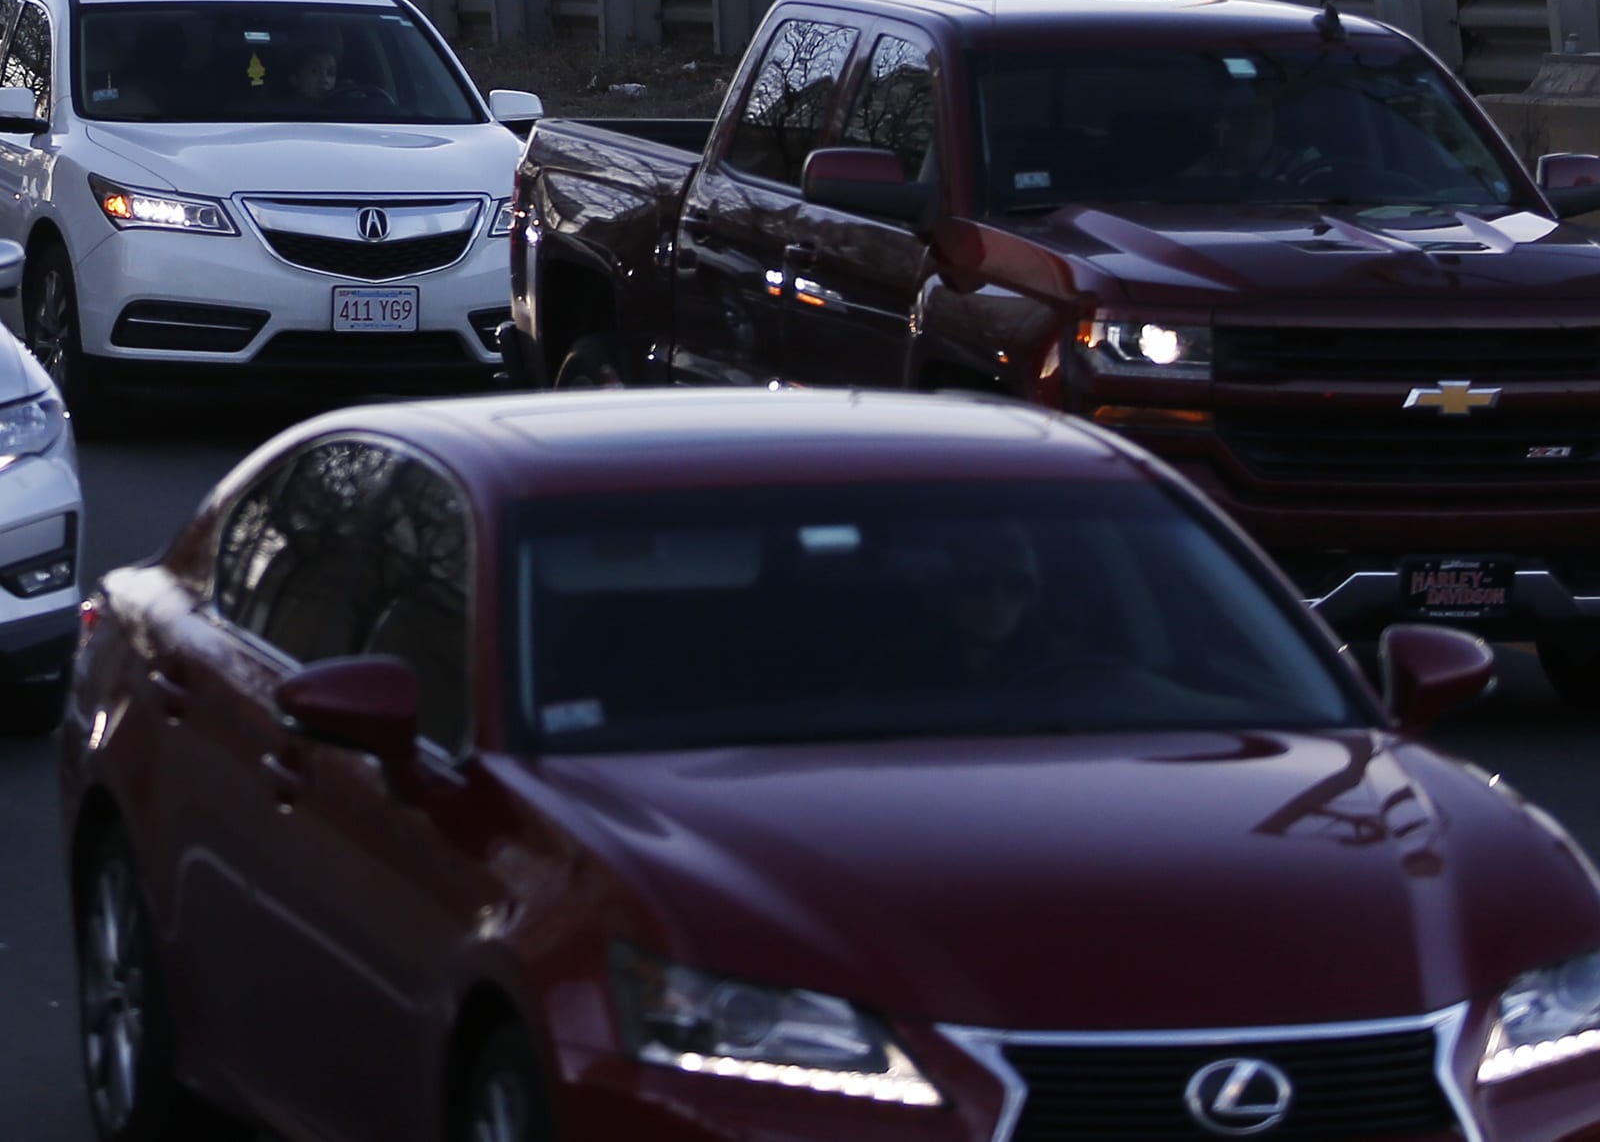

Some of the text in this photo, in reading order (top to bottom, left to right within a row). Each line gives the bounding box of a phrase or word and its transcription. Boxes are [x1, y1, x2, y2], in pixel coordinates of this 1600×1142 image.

[339, 299, 413, 321] 411 YG9
[1426, 587, 1506, 605] DAVIDSON
